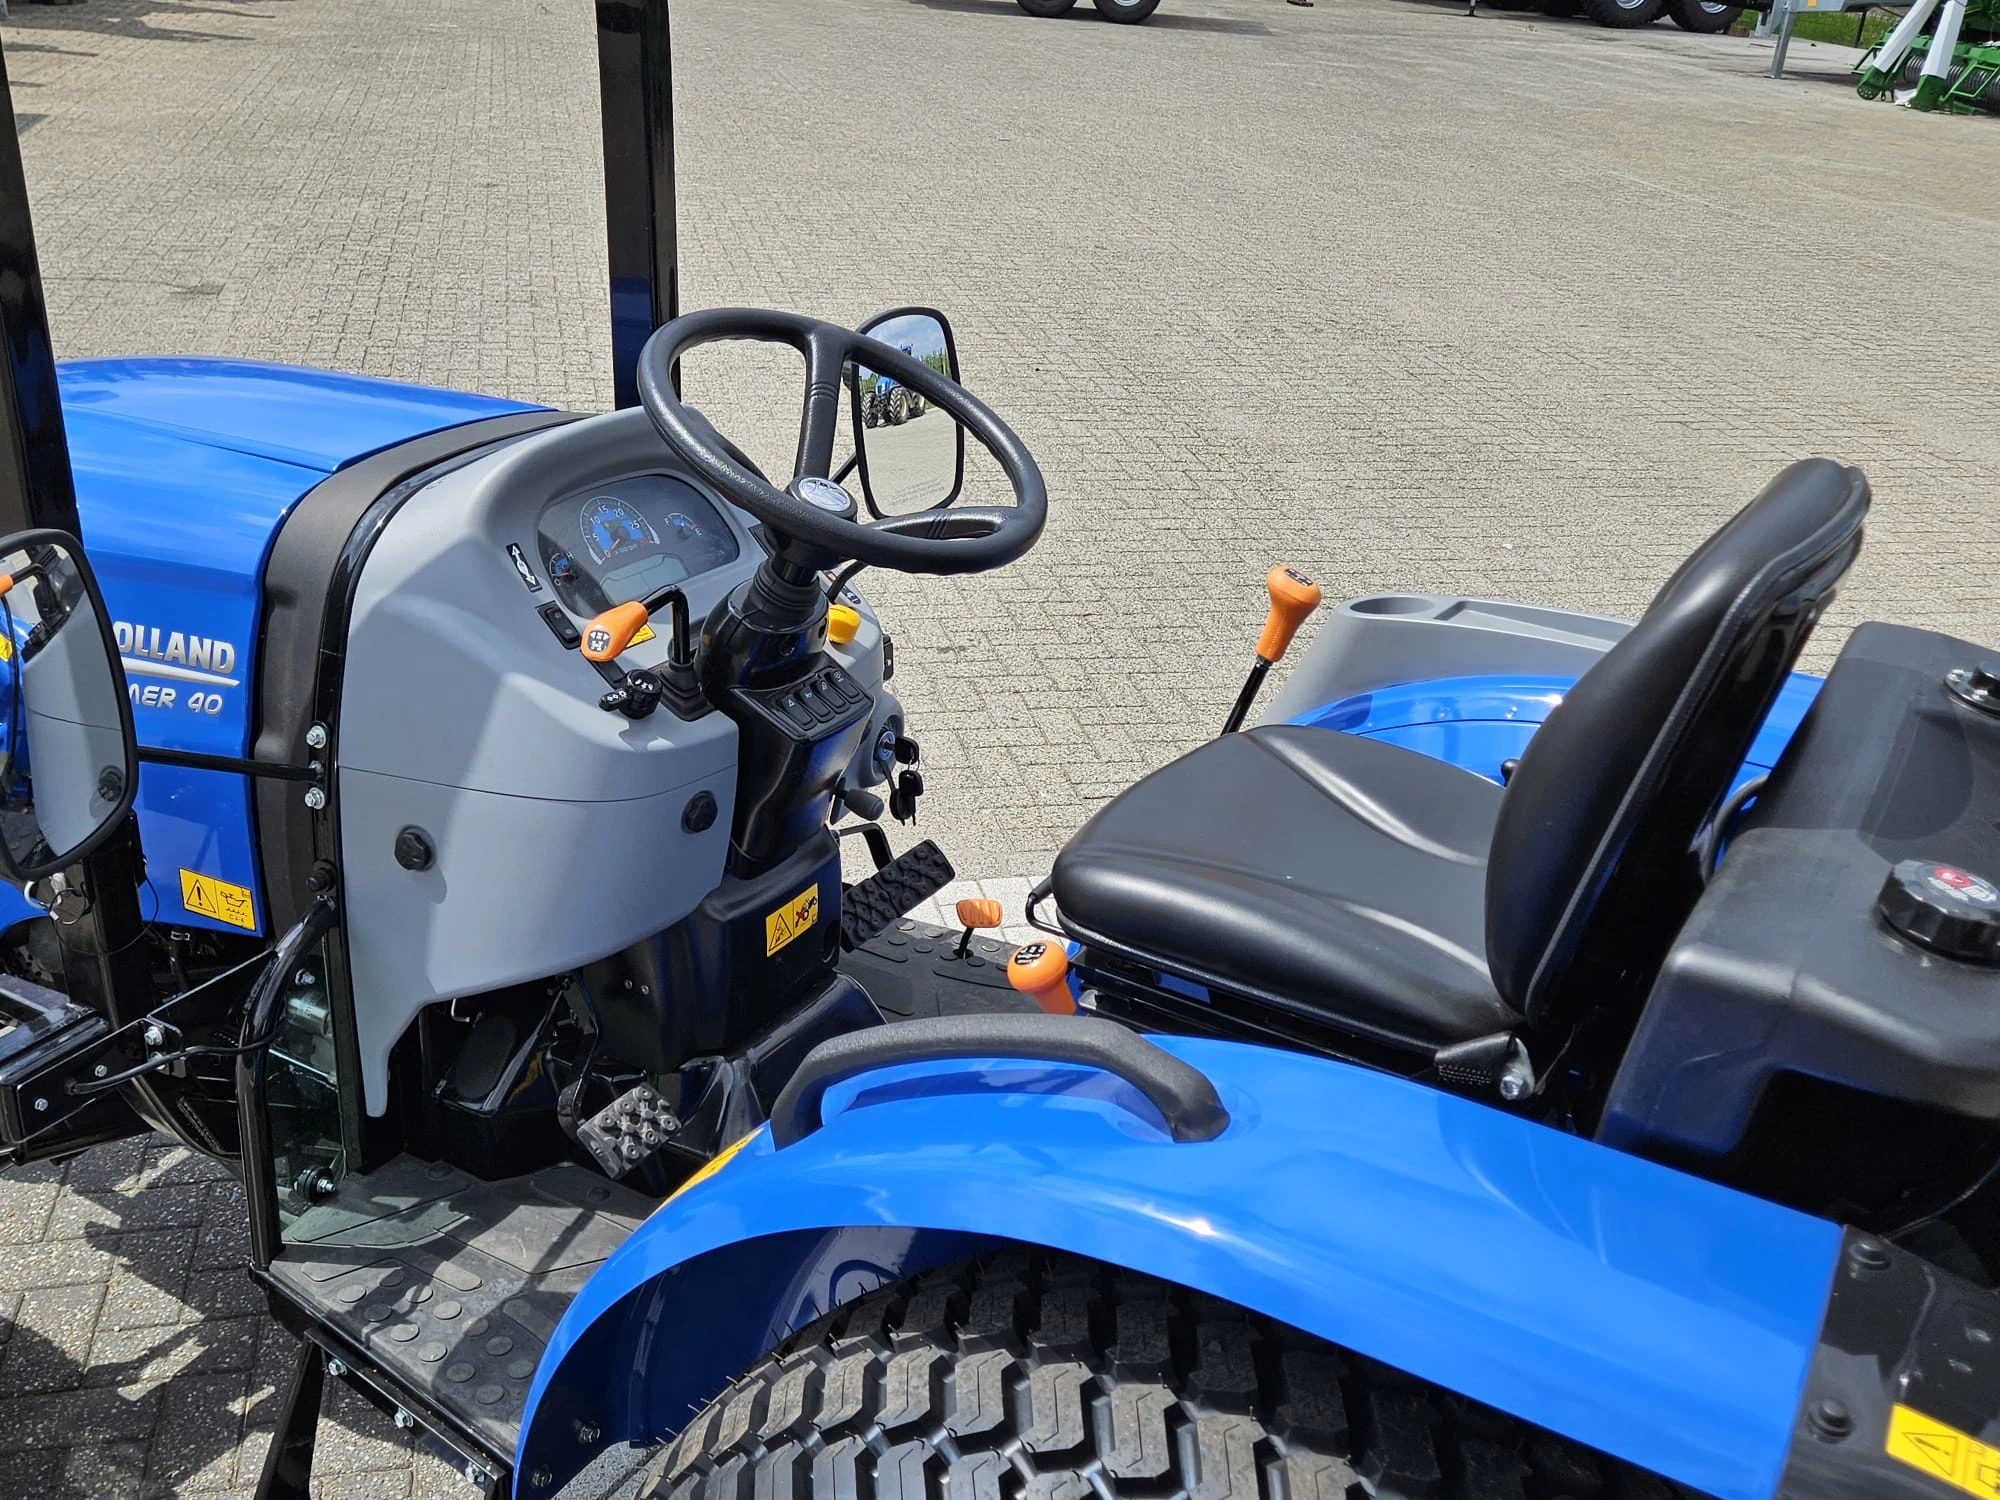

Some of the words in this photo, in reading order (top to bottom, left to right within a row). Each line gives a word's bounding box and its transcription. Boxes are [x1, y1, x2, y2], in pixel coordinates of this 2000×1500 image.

[598, 505, 609, 514] 15
[613, 508, 625, 518] 20
[589, 515, 601, 526] 10
[629, 519, 641, 530] 25
[187, 692, 223, 715] 40
